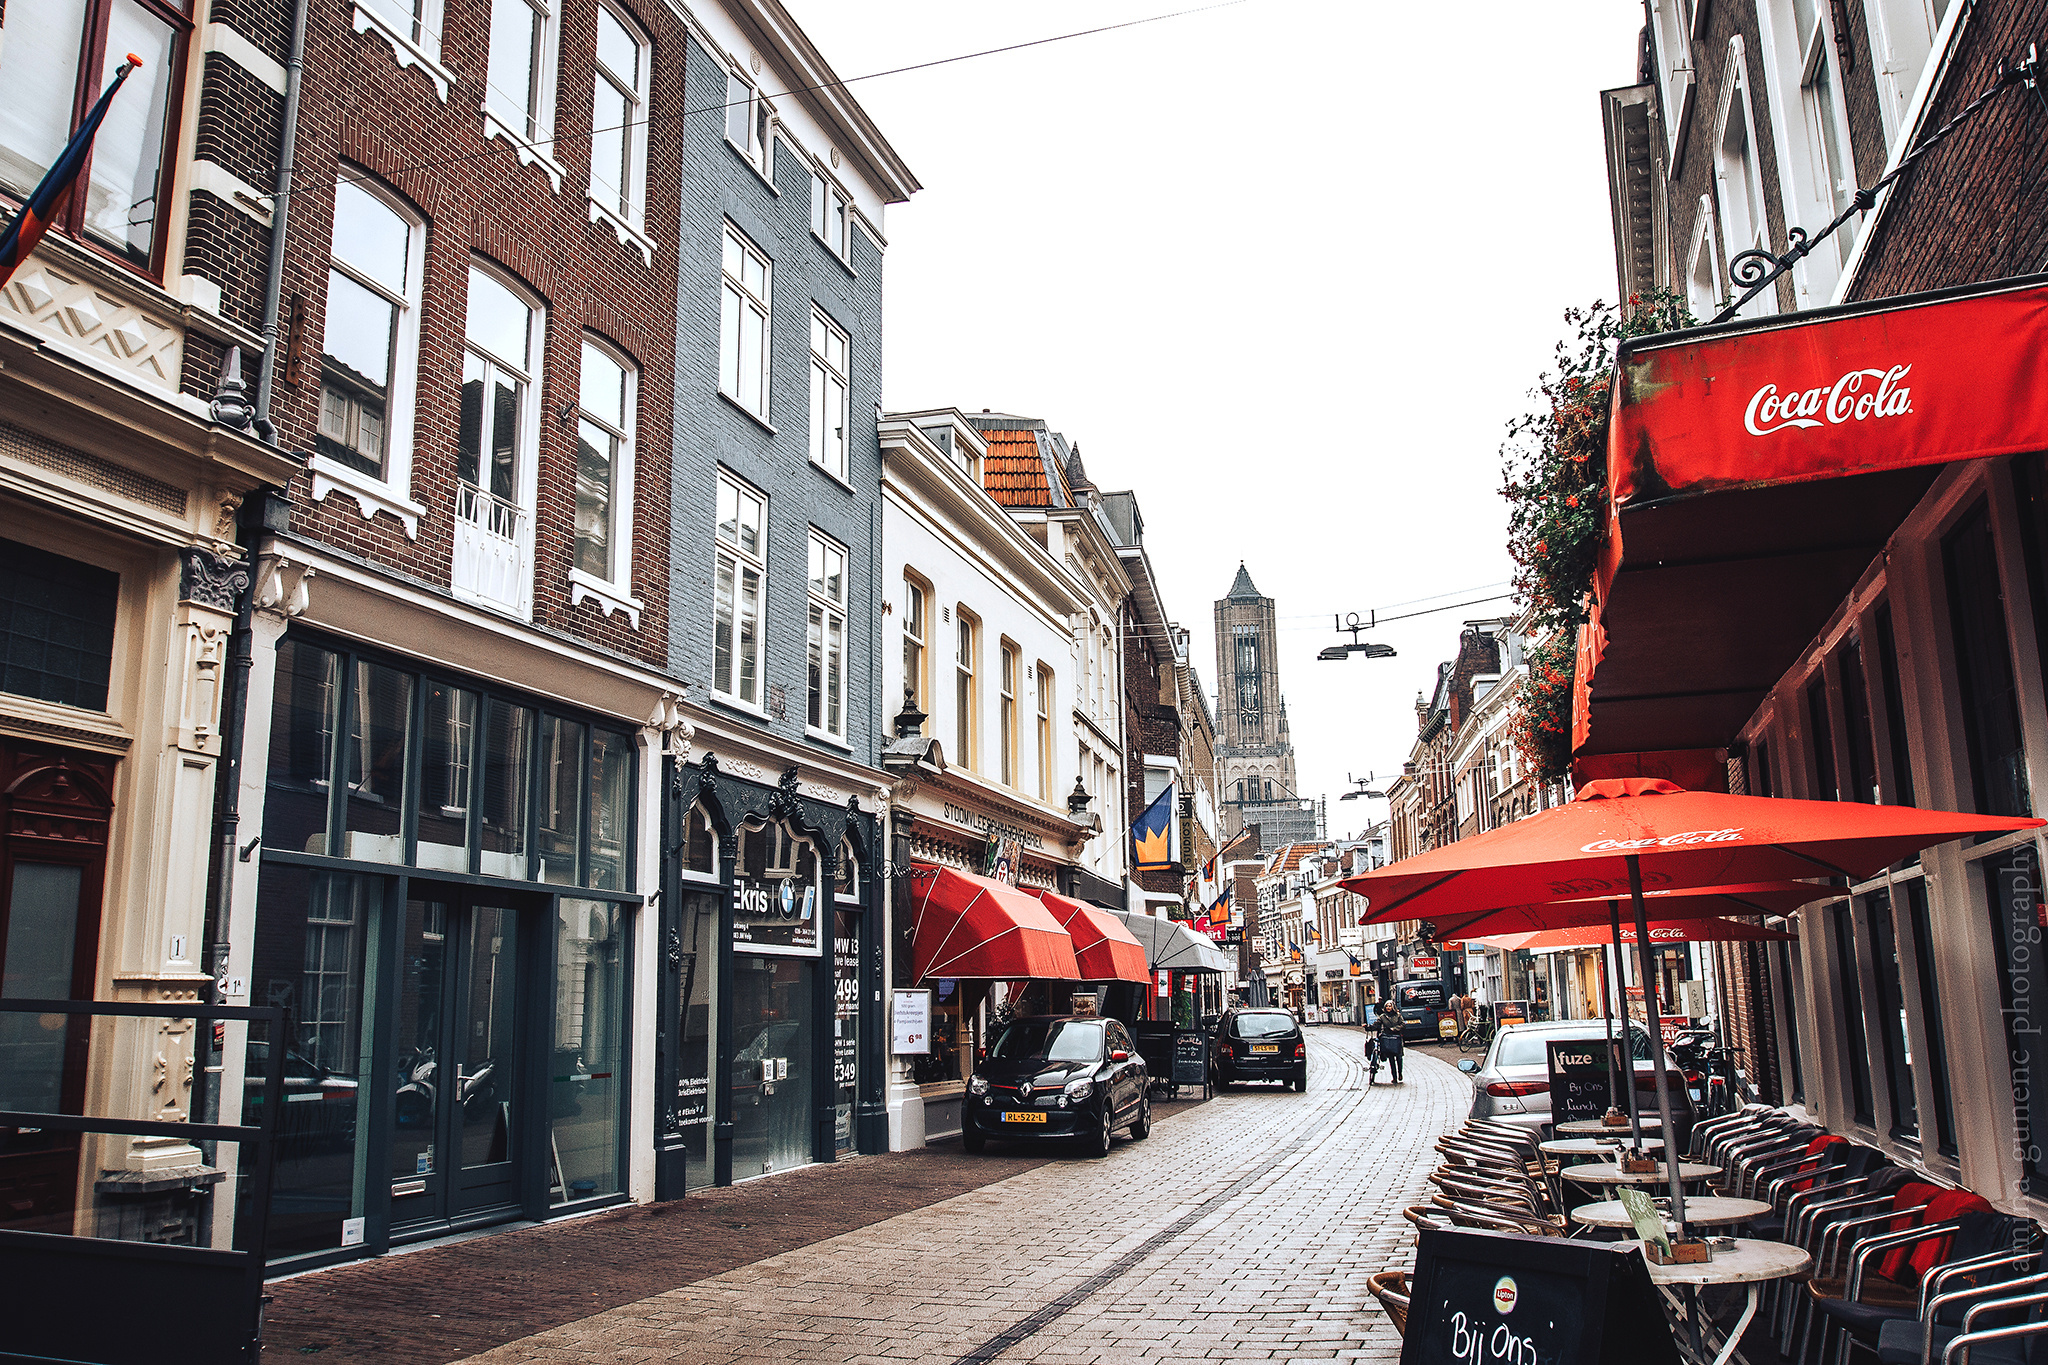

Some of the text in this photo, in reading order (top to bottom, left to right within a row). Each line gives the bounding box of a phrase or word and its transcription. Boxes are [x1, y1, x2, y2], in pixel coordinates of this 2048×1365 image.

[1743, 363, 1913, 436] Coca-Cola
[1182, 821, 1191, 863] STUDIO'S
[1580, 827, 1744, 853] Coca-Cola
[734, 879, 768, 912] Ekris
[1619, 928, 1687, 939] CocCola
[175, 939, 180, 956] 1
[851, 938, 859, 954] i3
[844, 955, 859, 966] lease
[834, 979, 859, 1001] 499
[846, 1002, 859, 1010] maand
[1566, 1098, 1598, 1111] Lunch
[1007, 1113, 1043, 1121] RL-522-L
[1497, 1290, 1514, 1300] Lipton
[1451, 1311, 1537, 1365] Bij Ons
